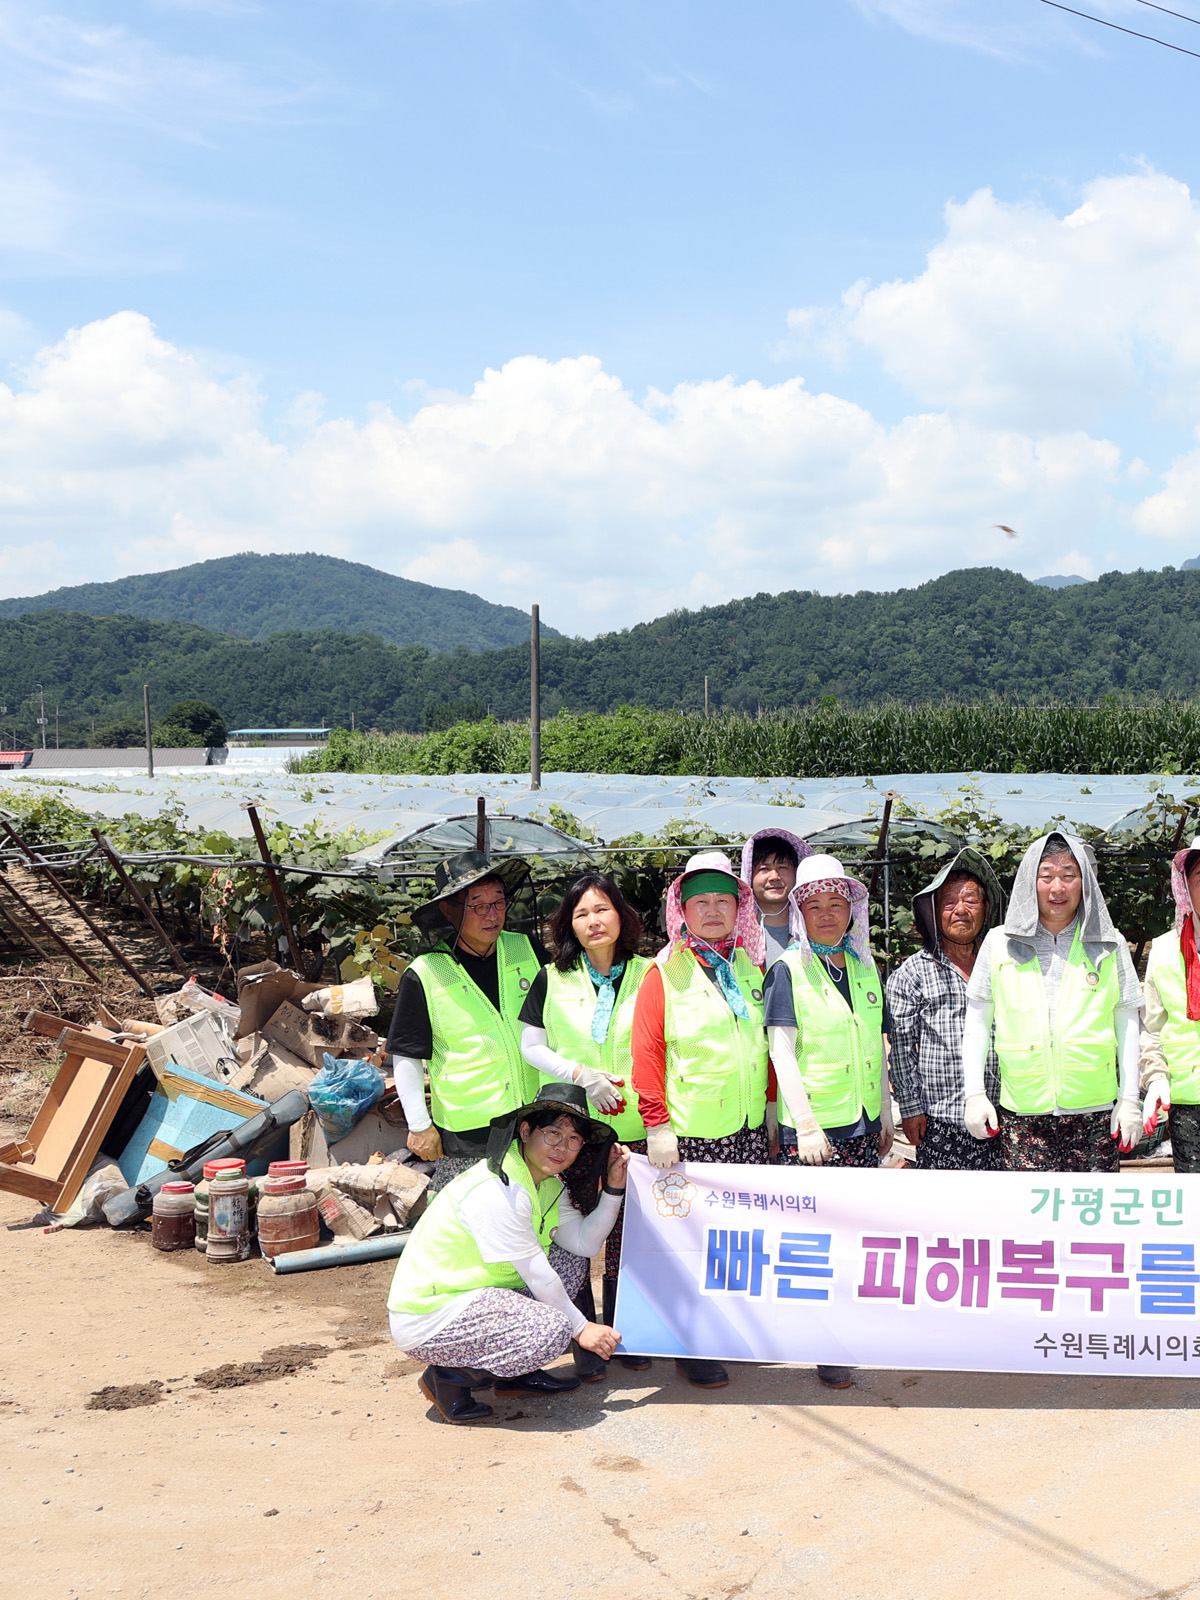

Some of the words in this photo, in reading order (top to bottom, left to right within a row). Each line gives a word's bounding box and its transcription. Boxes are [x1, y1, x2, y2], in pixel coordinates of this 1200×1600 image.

[704, 1190, 817, 1213] 수원특례시의회
[1030, 1187, 1184, 1226] 가평군민
[704, 1228, 833, 1300] 빠른
[857, 1235, 1200, 1315] 피해복구를
